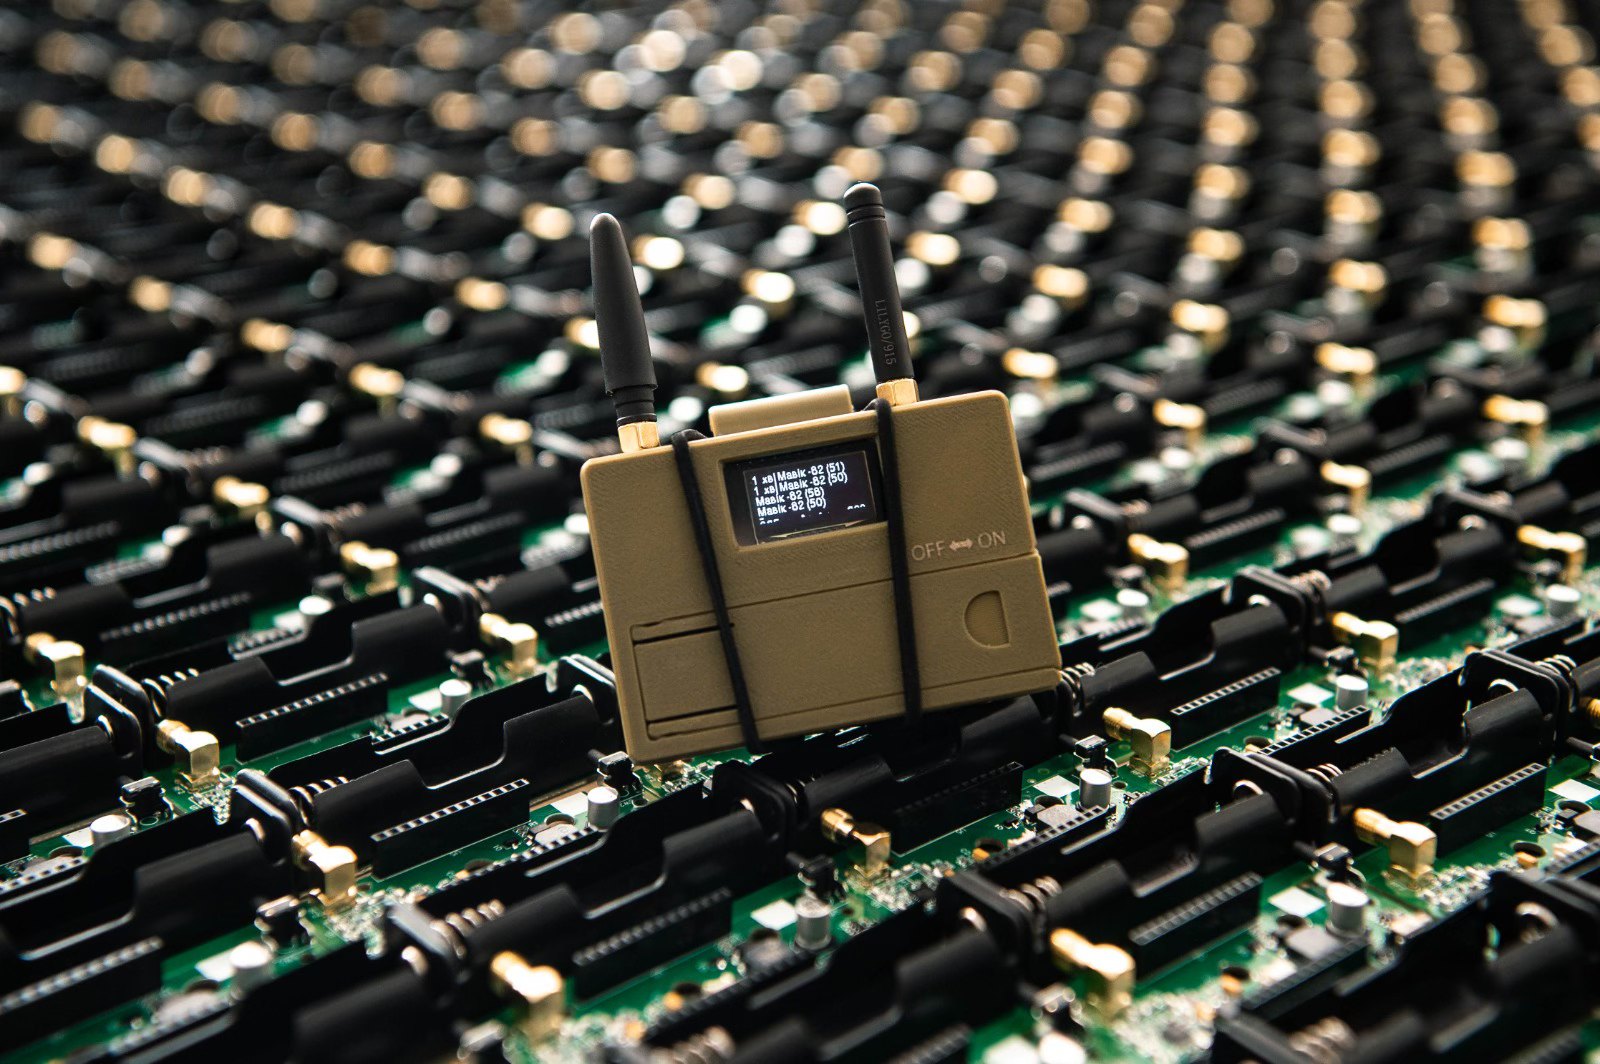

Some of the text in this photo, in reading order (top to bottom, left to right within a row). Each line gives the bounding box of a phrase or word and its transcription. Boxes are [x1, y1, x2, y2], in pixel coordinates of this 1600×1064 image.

[875, 299, 897, 365] LILYGO/915
[752, 475, 758, 486] 1
[808, 465, 824, 475] -82
[826, 462, 845, 474] (51)
[753, 486, 759, 496] 1
[810, 475, 826, 486] -82
[828, 472, 848, 486] (50)
[786, 490, 803, 501] -82
[788, 500, 805, 512] -82
[806, 496, 827, 511] (50)
[911, 530, 1006, 561] OFF ON
